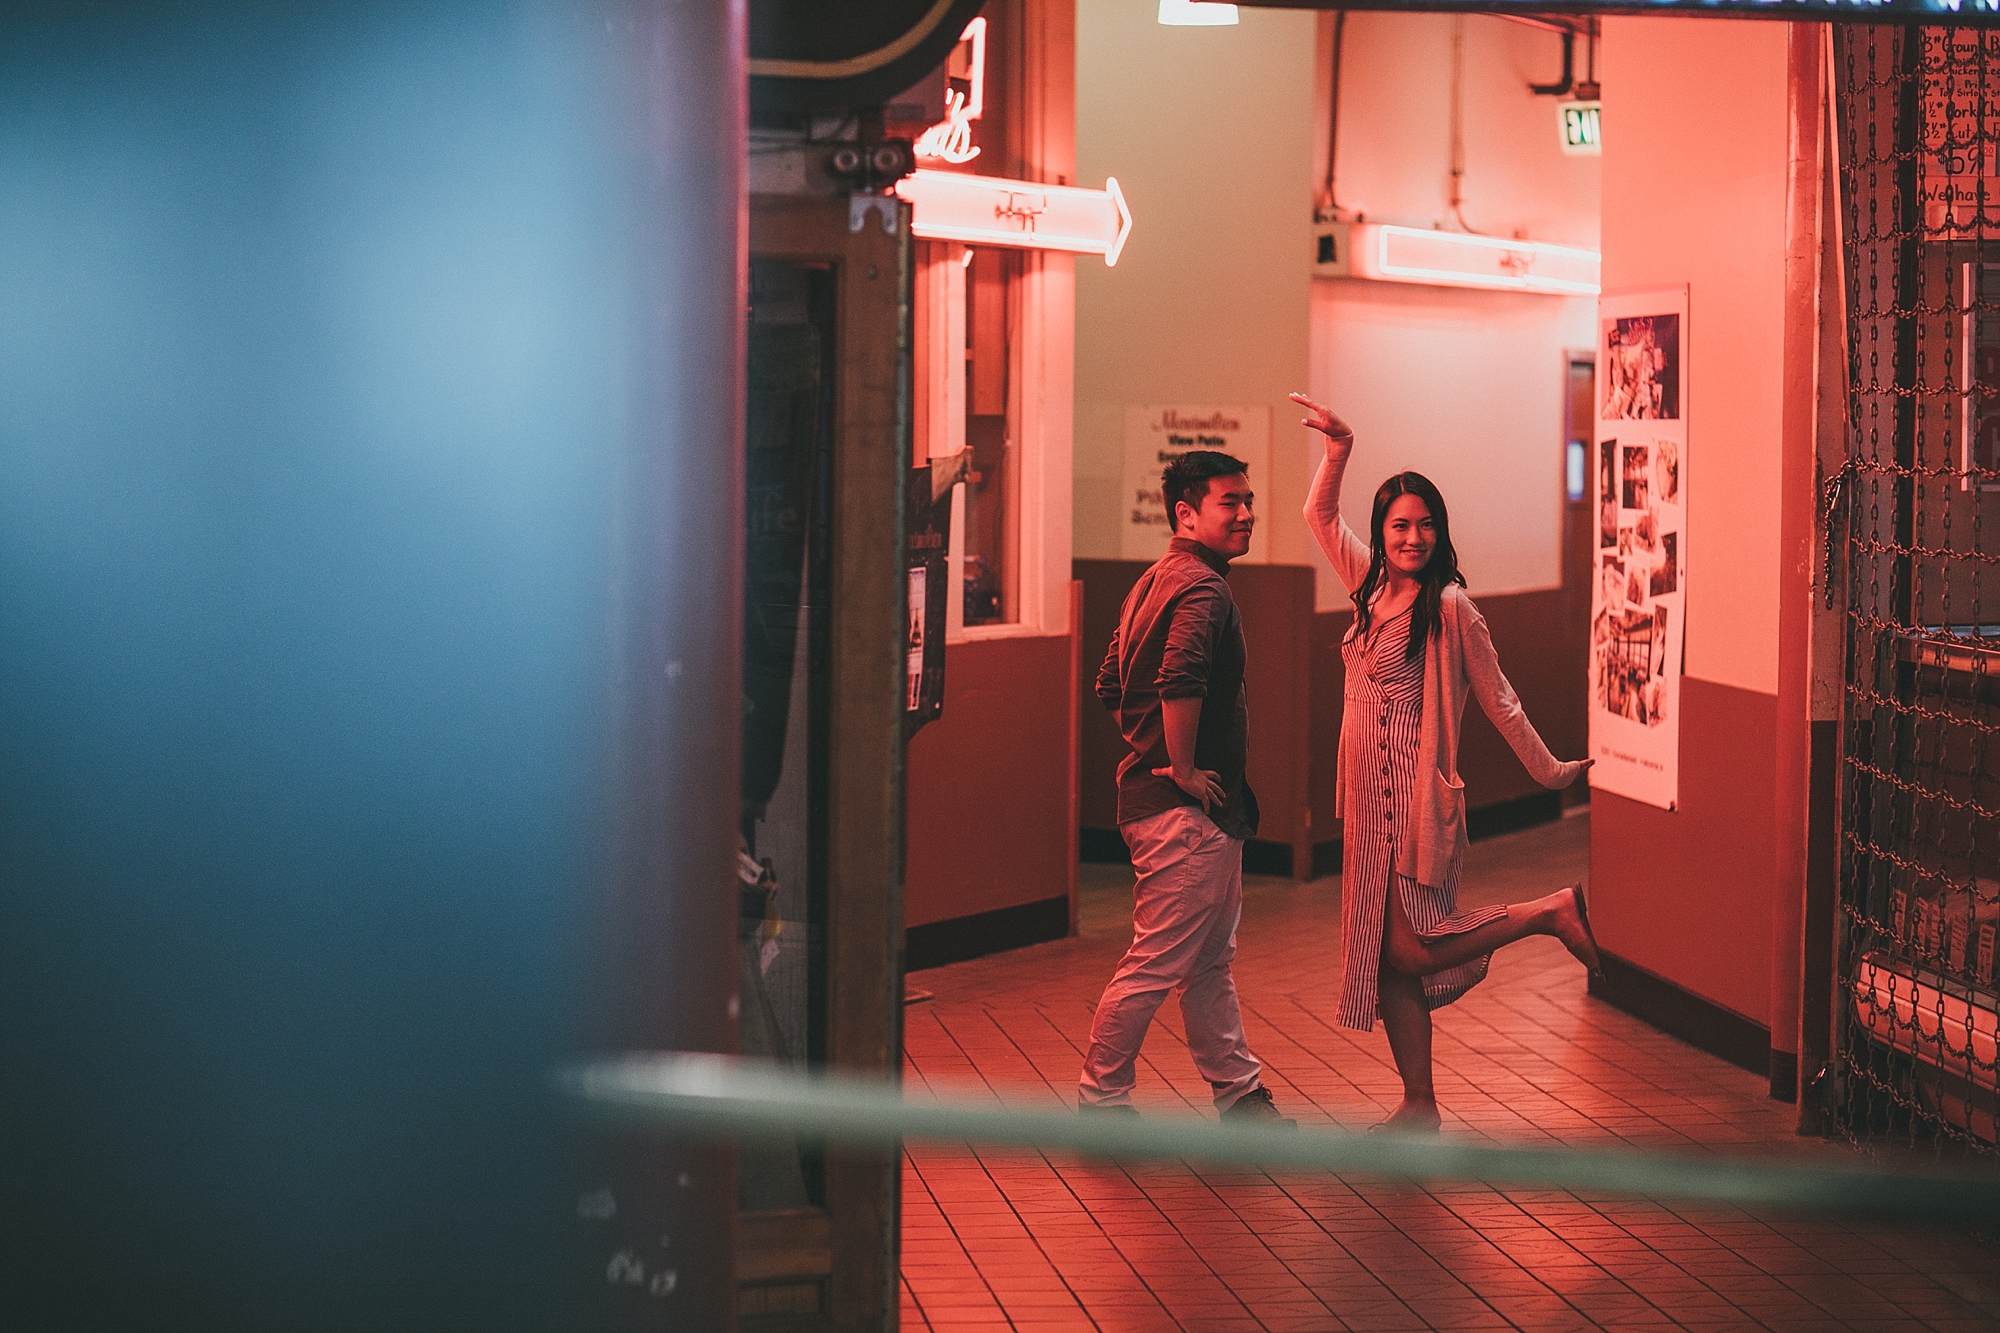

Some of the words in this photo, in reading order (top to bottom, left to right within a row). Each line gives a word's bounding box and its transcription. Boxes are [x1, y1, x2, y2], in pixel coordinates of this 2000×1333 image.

[1942, 35, 1982, 52] Groun
[1965, 79, 1991, 89] Prie
[1957, 88, 1987, 98] Sirlon
[1949, 101, 1978, 118] ork
